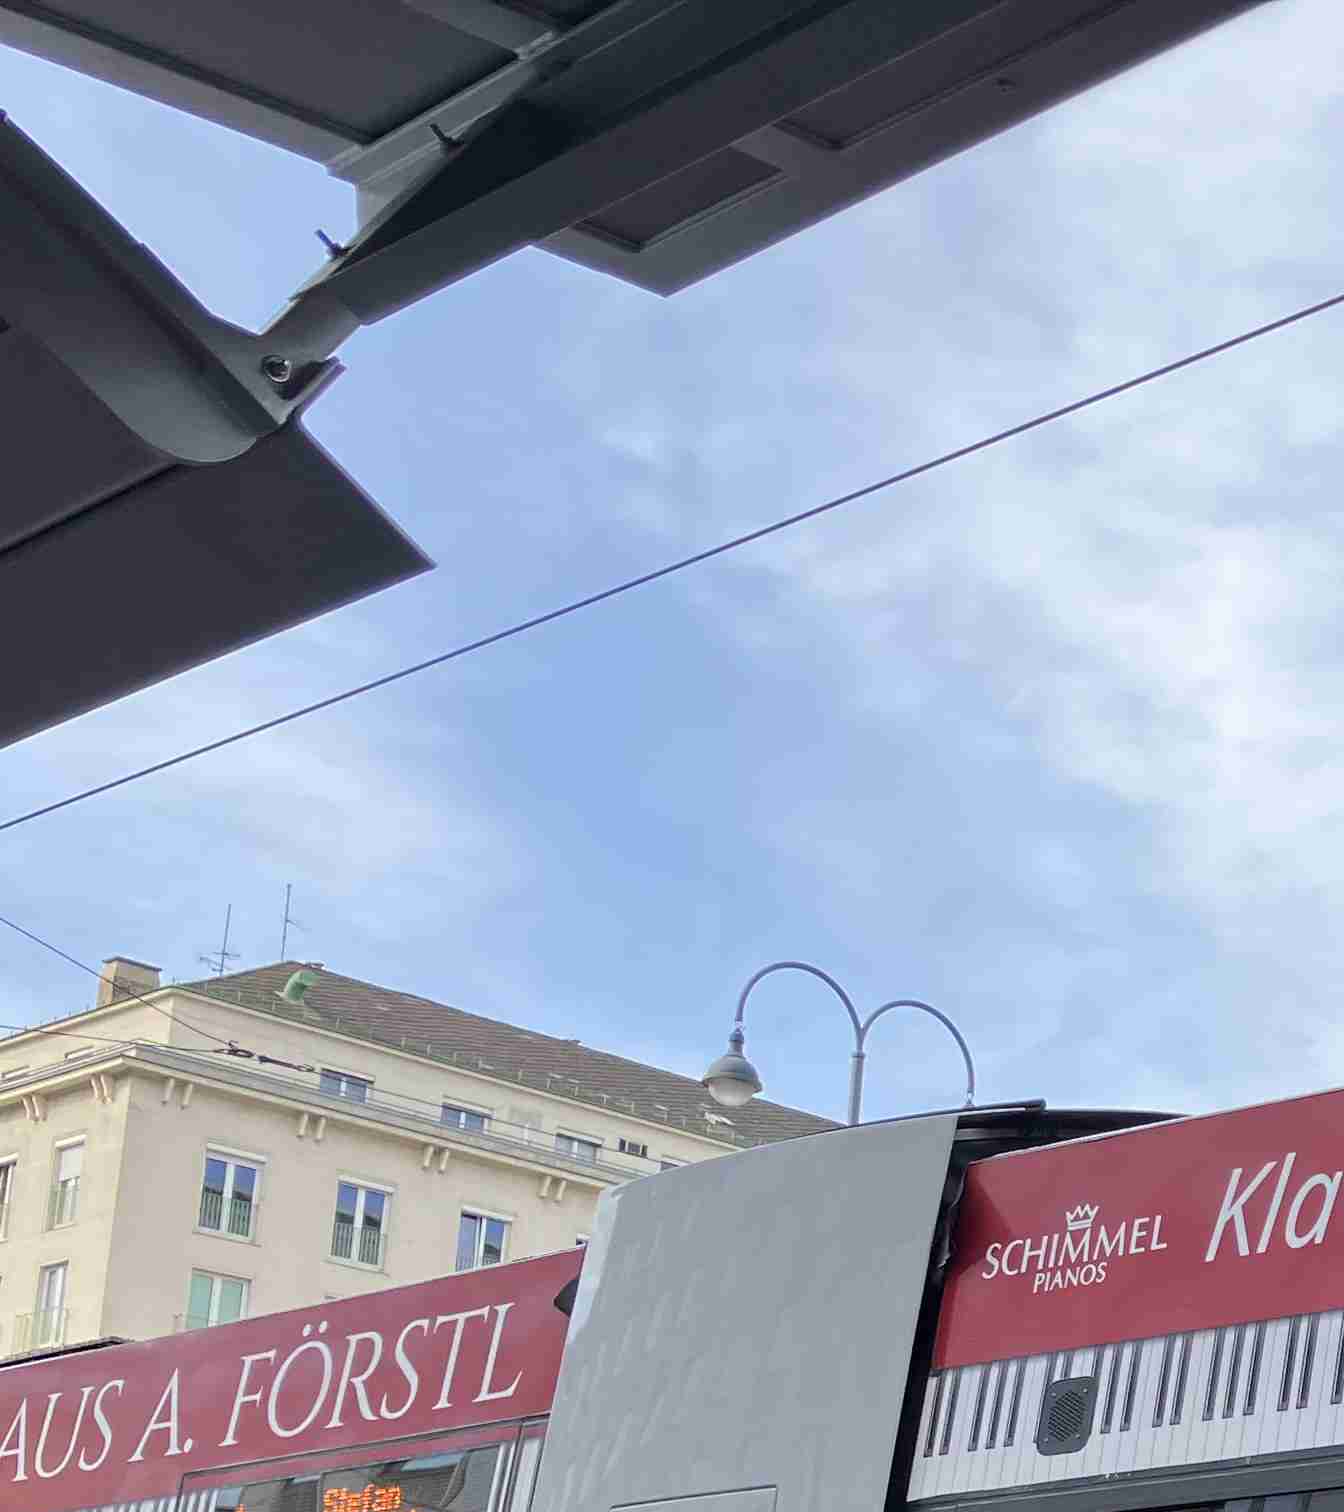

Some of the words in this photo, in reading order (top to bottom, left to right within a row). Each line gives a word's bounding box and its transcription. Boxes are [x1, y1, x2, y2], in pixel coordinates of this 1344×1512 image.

[982, 1215, 1168, 1280] SCHIMMEL
[1033, 1261, 1108, 1294] PIANOS
[128, 1367, 193, 1463] A.
[219, 1302, 523, 1447] FÖRSTL
